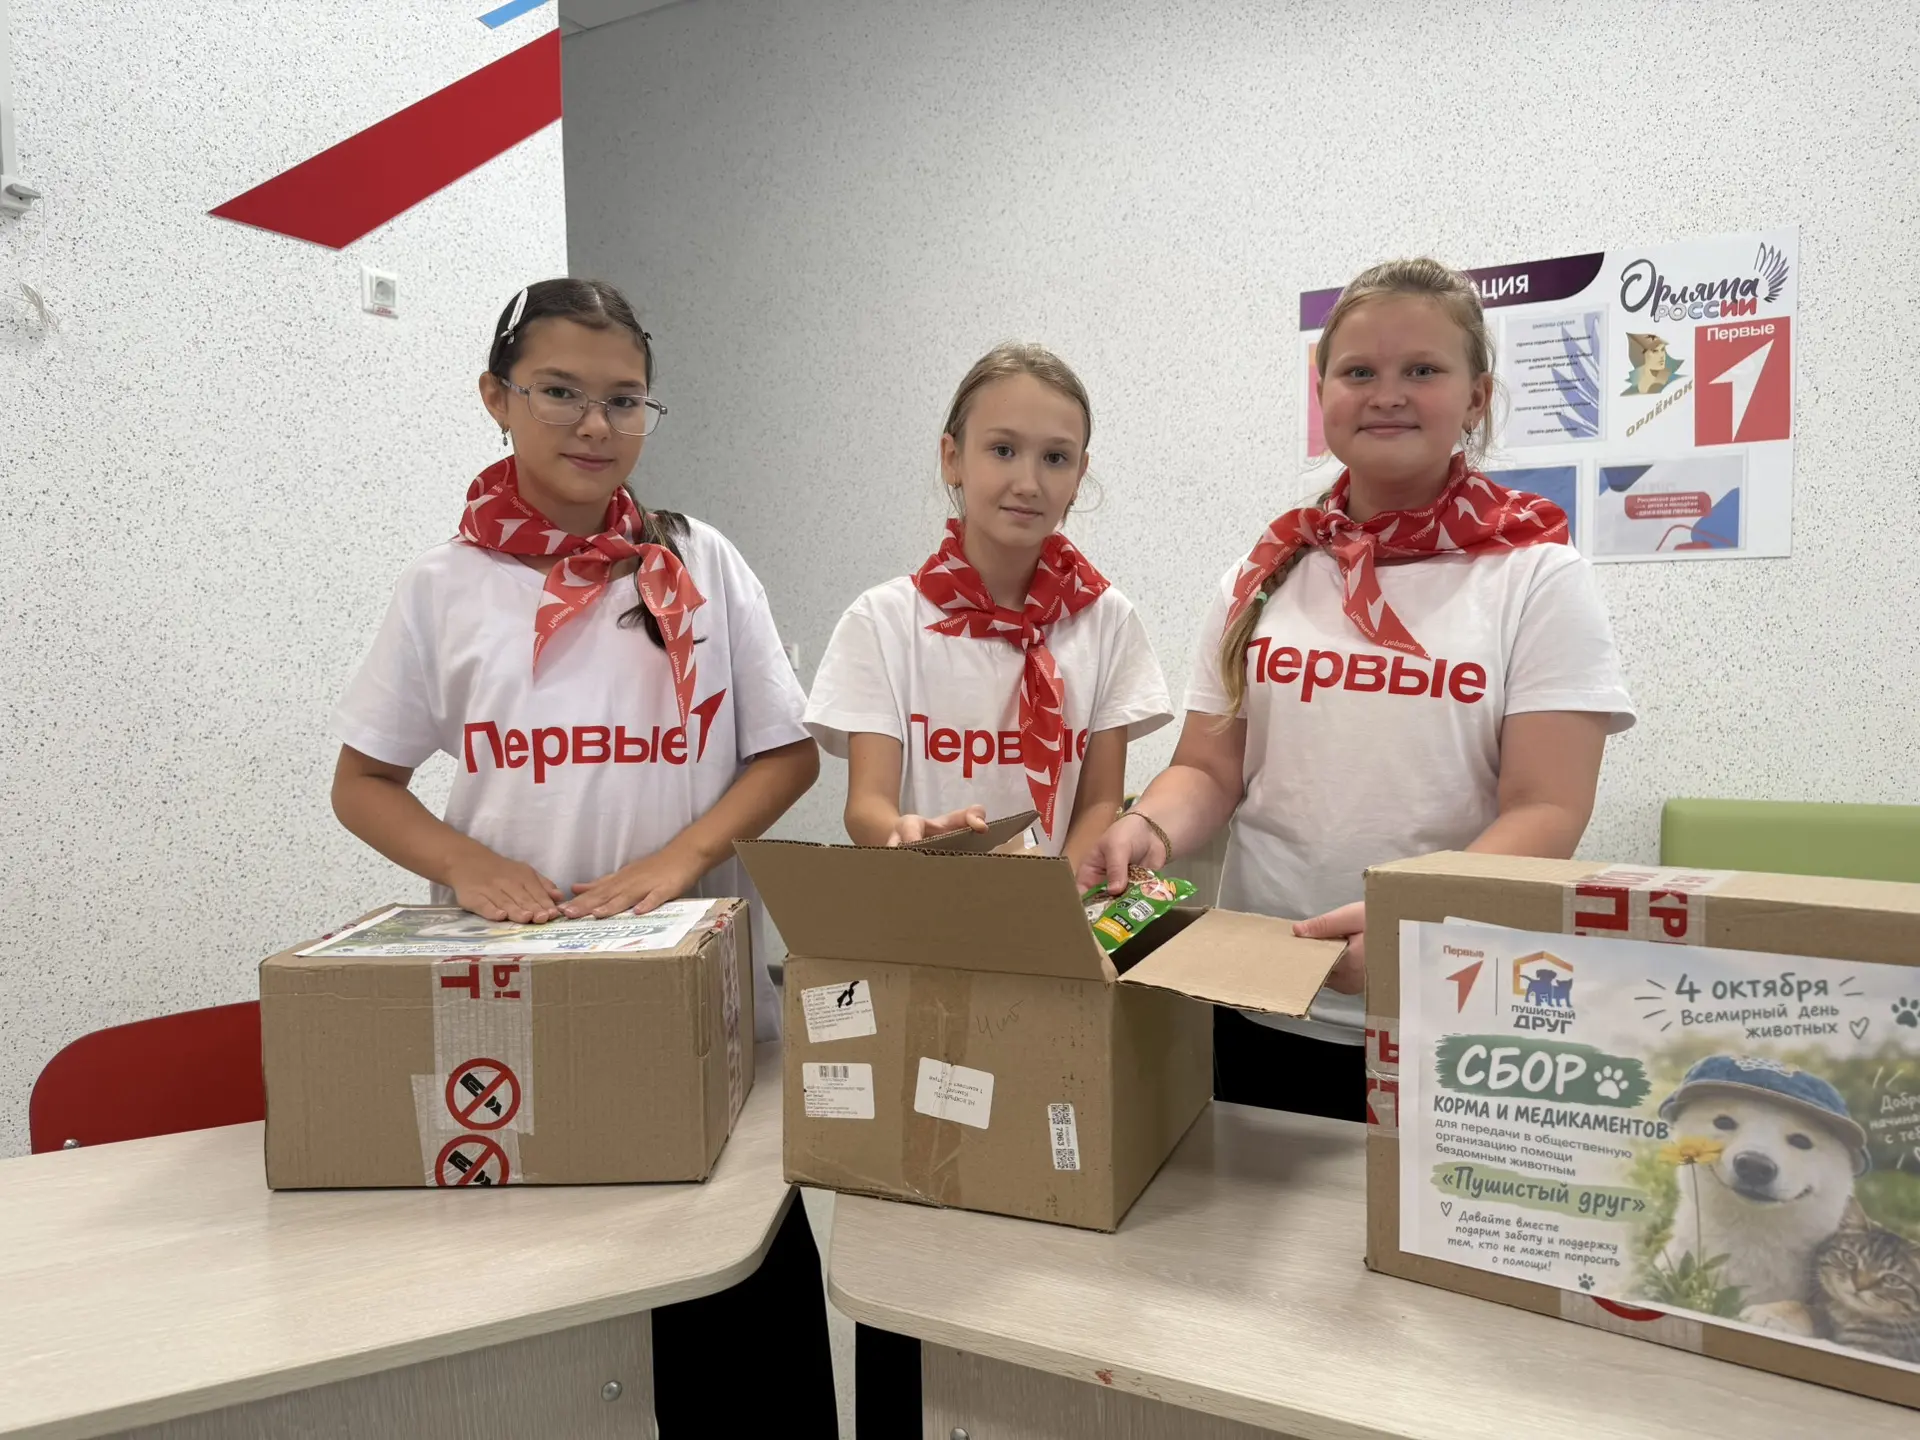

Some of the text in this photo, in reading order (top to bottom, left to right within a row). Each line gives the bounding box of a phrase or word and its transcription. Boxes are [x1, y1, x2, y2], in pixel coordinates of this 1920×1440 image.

[1620, 258, 1760, 317] Орлята
[1707, 323, 1775, 342] Первые
[1626, 380, 1693, 437] ОРЛЁНОК
[1246, 637, 1487, 704] Первые
[464, 720, 688, 784] Первые
[1443, 945, 1484, 958] Первые
[1675, 972, 1829, 1003] 4 октября
[1511, 1004, 1576, 1020] ПУШИСТЫЙ
[1513, 1015, 1573, 1034] ДРУГ
[1681, 1003, 1840, 1026] Всемирный день
[1746, 1023, 1839, 1040] животных
[1456, 1044, 1587, 1096] СБОР
[1433, 1095, 1669, 1140] КОРМА И МЕДИКАМЕНТОВ
[1870, 1114, 1920, 1131] начина
[1055, 1127, 1065, 1146] 7963
[1435, 1119, 1632, 1159] для передачи в общественную
[1436, 1132, 1573, 1163] организацию помощи
[1884, 1125, 1920, 1144] с теб
[1436, 1143, 1576, 1177] бездомным животным
[1442, 1166, 1647, 1217] «Пушистый друг»
[1458, 1211, 1560, 1232] Давайте вместе
[1447, 1237, 1621, 1267] тем, кто не может попросить
[1455, 1224, 1500, 1238] подарим
[1505, 1230, 1543, 1244] заботу
[1559, 1238, 1618, 1254] поддержку
[1492, 1256, 1551, 1271] о помощи!
